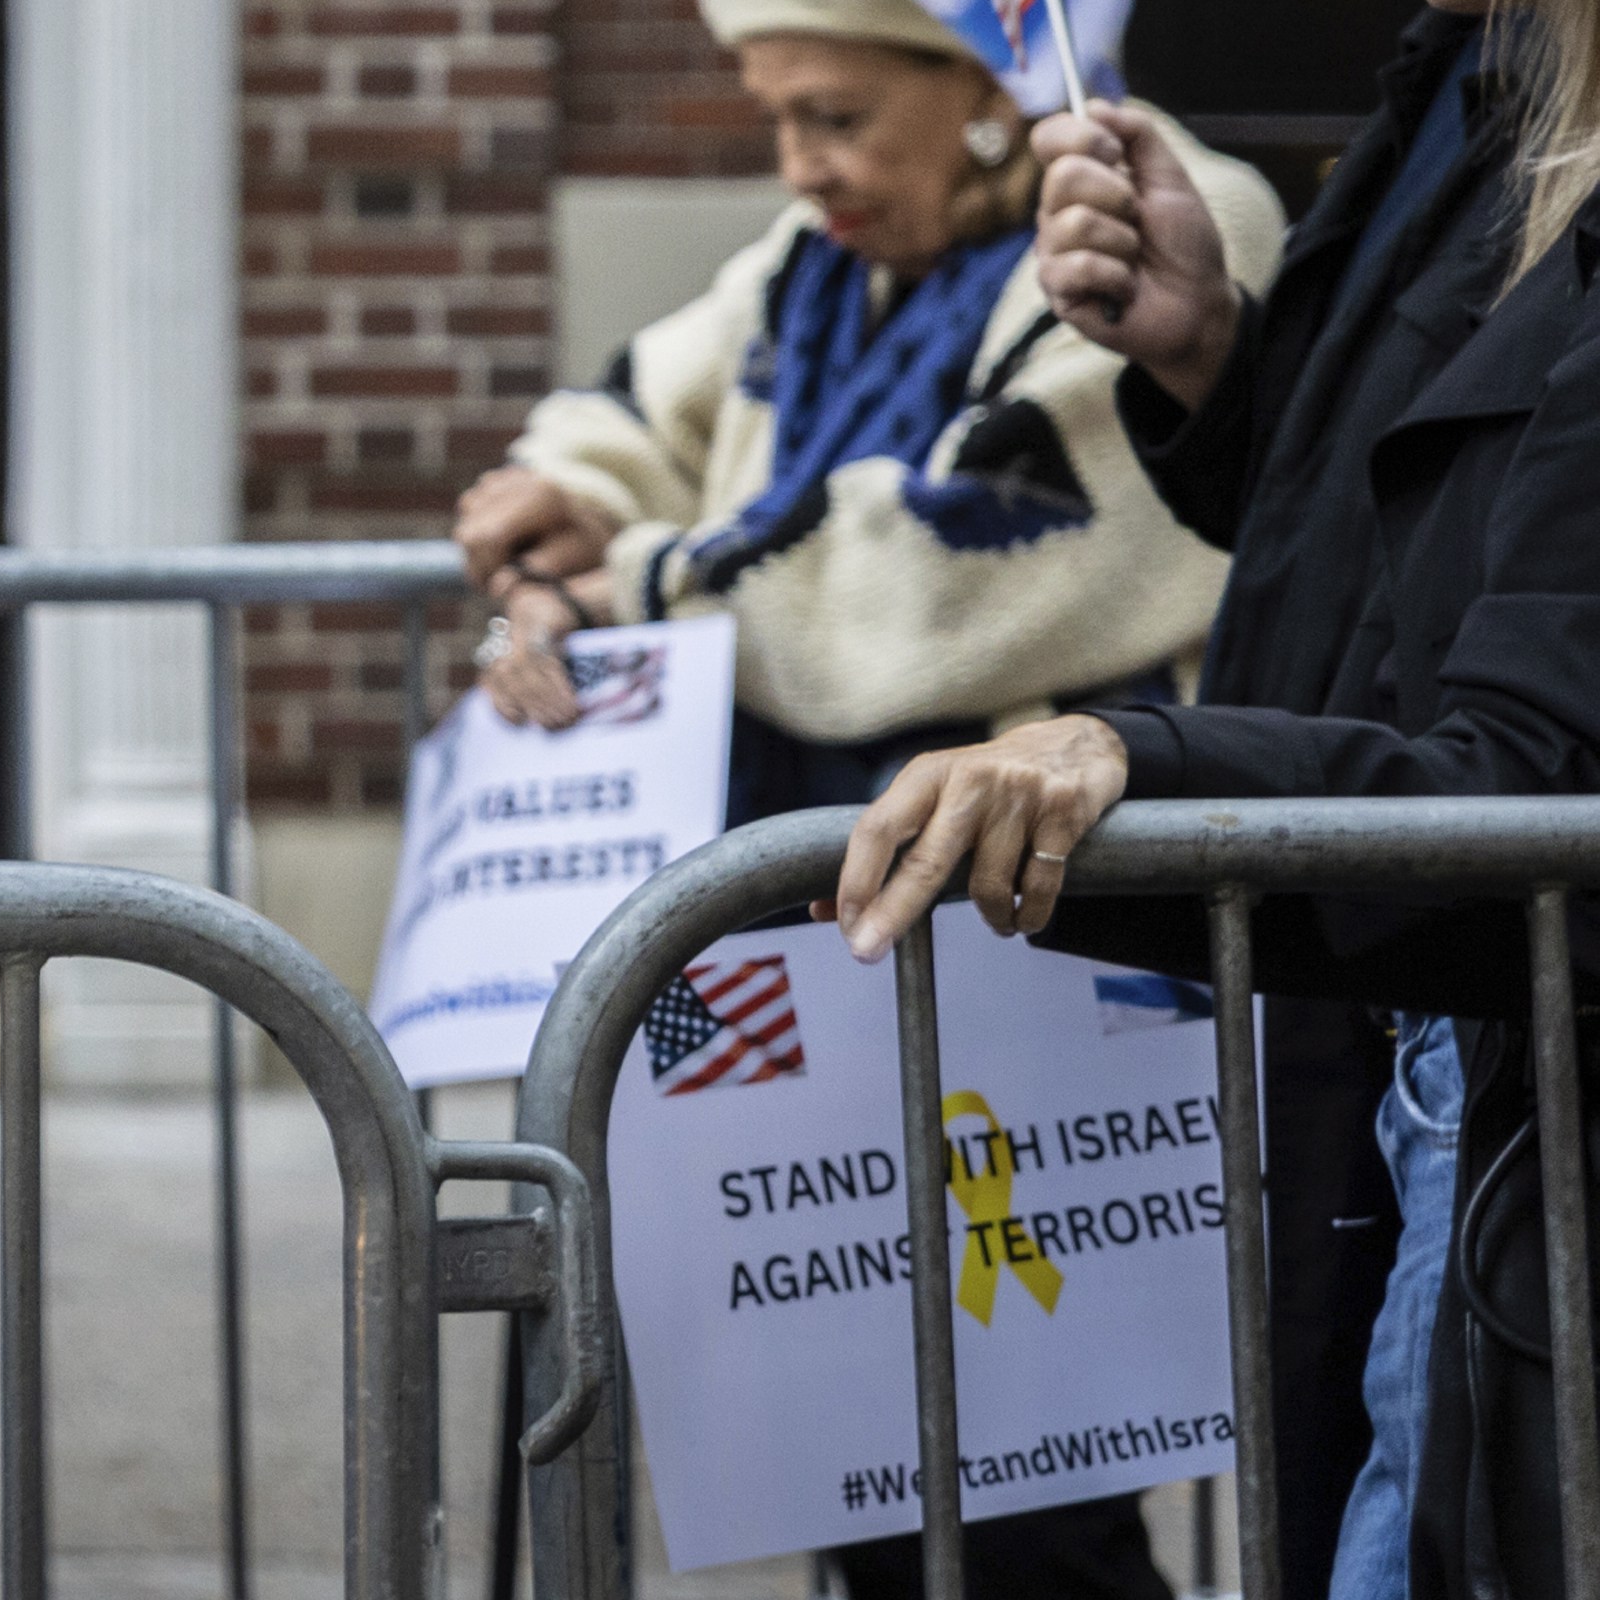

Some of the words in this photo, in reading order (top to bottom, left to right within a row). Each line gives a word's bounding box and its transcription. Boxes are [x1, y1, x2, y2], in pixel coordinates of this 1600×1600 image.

[720, 1149, 897, 1218] STAND
[730, 1227, 952, 1310] AGAINS
[965, 1183, 1226, 1267] TERRORIS
